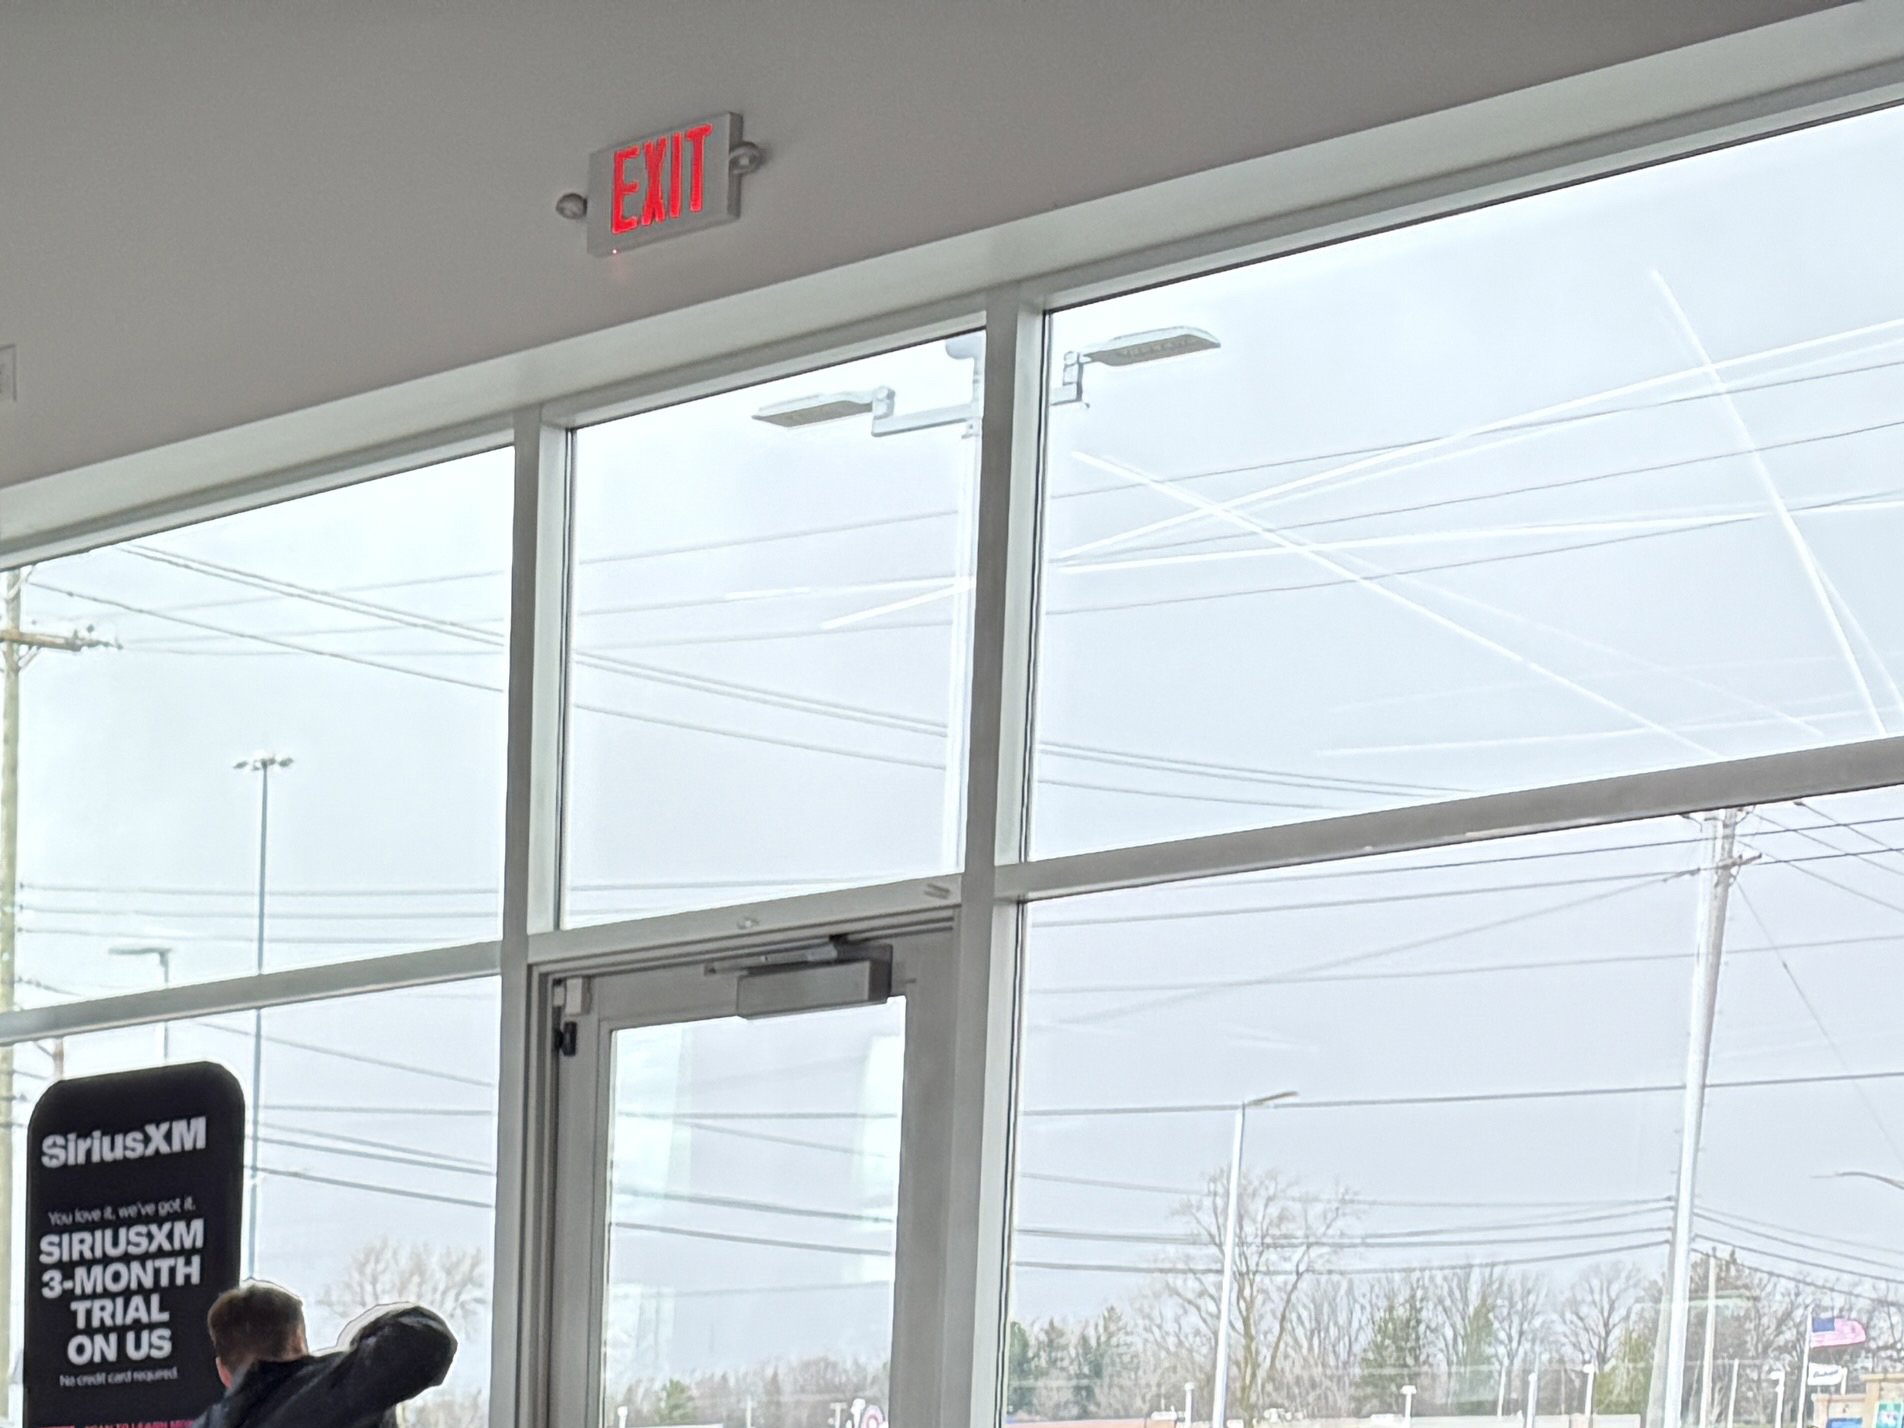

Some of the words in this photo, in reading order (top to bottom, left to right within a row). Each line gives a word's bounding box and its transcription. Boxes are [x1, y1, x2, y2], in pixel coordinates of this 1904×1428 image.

[611, 123, 713, 234] EXIT
[41, 1115, 207, 1169] SiriusXM
[47, 1211, 73, 1226] You
[74, 1208, 102, 1223] love
[117, 1202, 156, 1219] we've
[157, 1198, 181, 1216] got
[39, 1217, 204, 1264] SIRIUSXM
[41, 1254, 201, 1299] 3-MONTH
[70, 1292, 170, 1329] TRIAL
[67, 1332, 118, 1365] ON
[125, 1328, 173, 1361] US
[59, 1374, 76, 1387] No
[77, 1371, 106, 1386] credit
[107, 1370, 132, 1384] card
